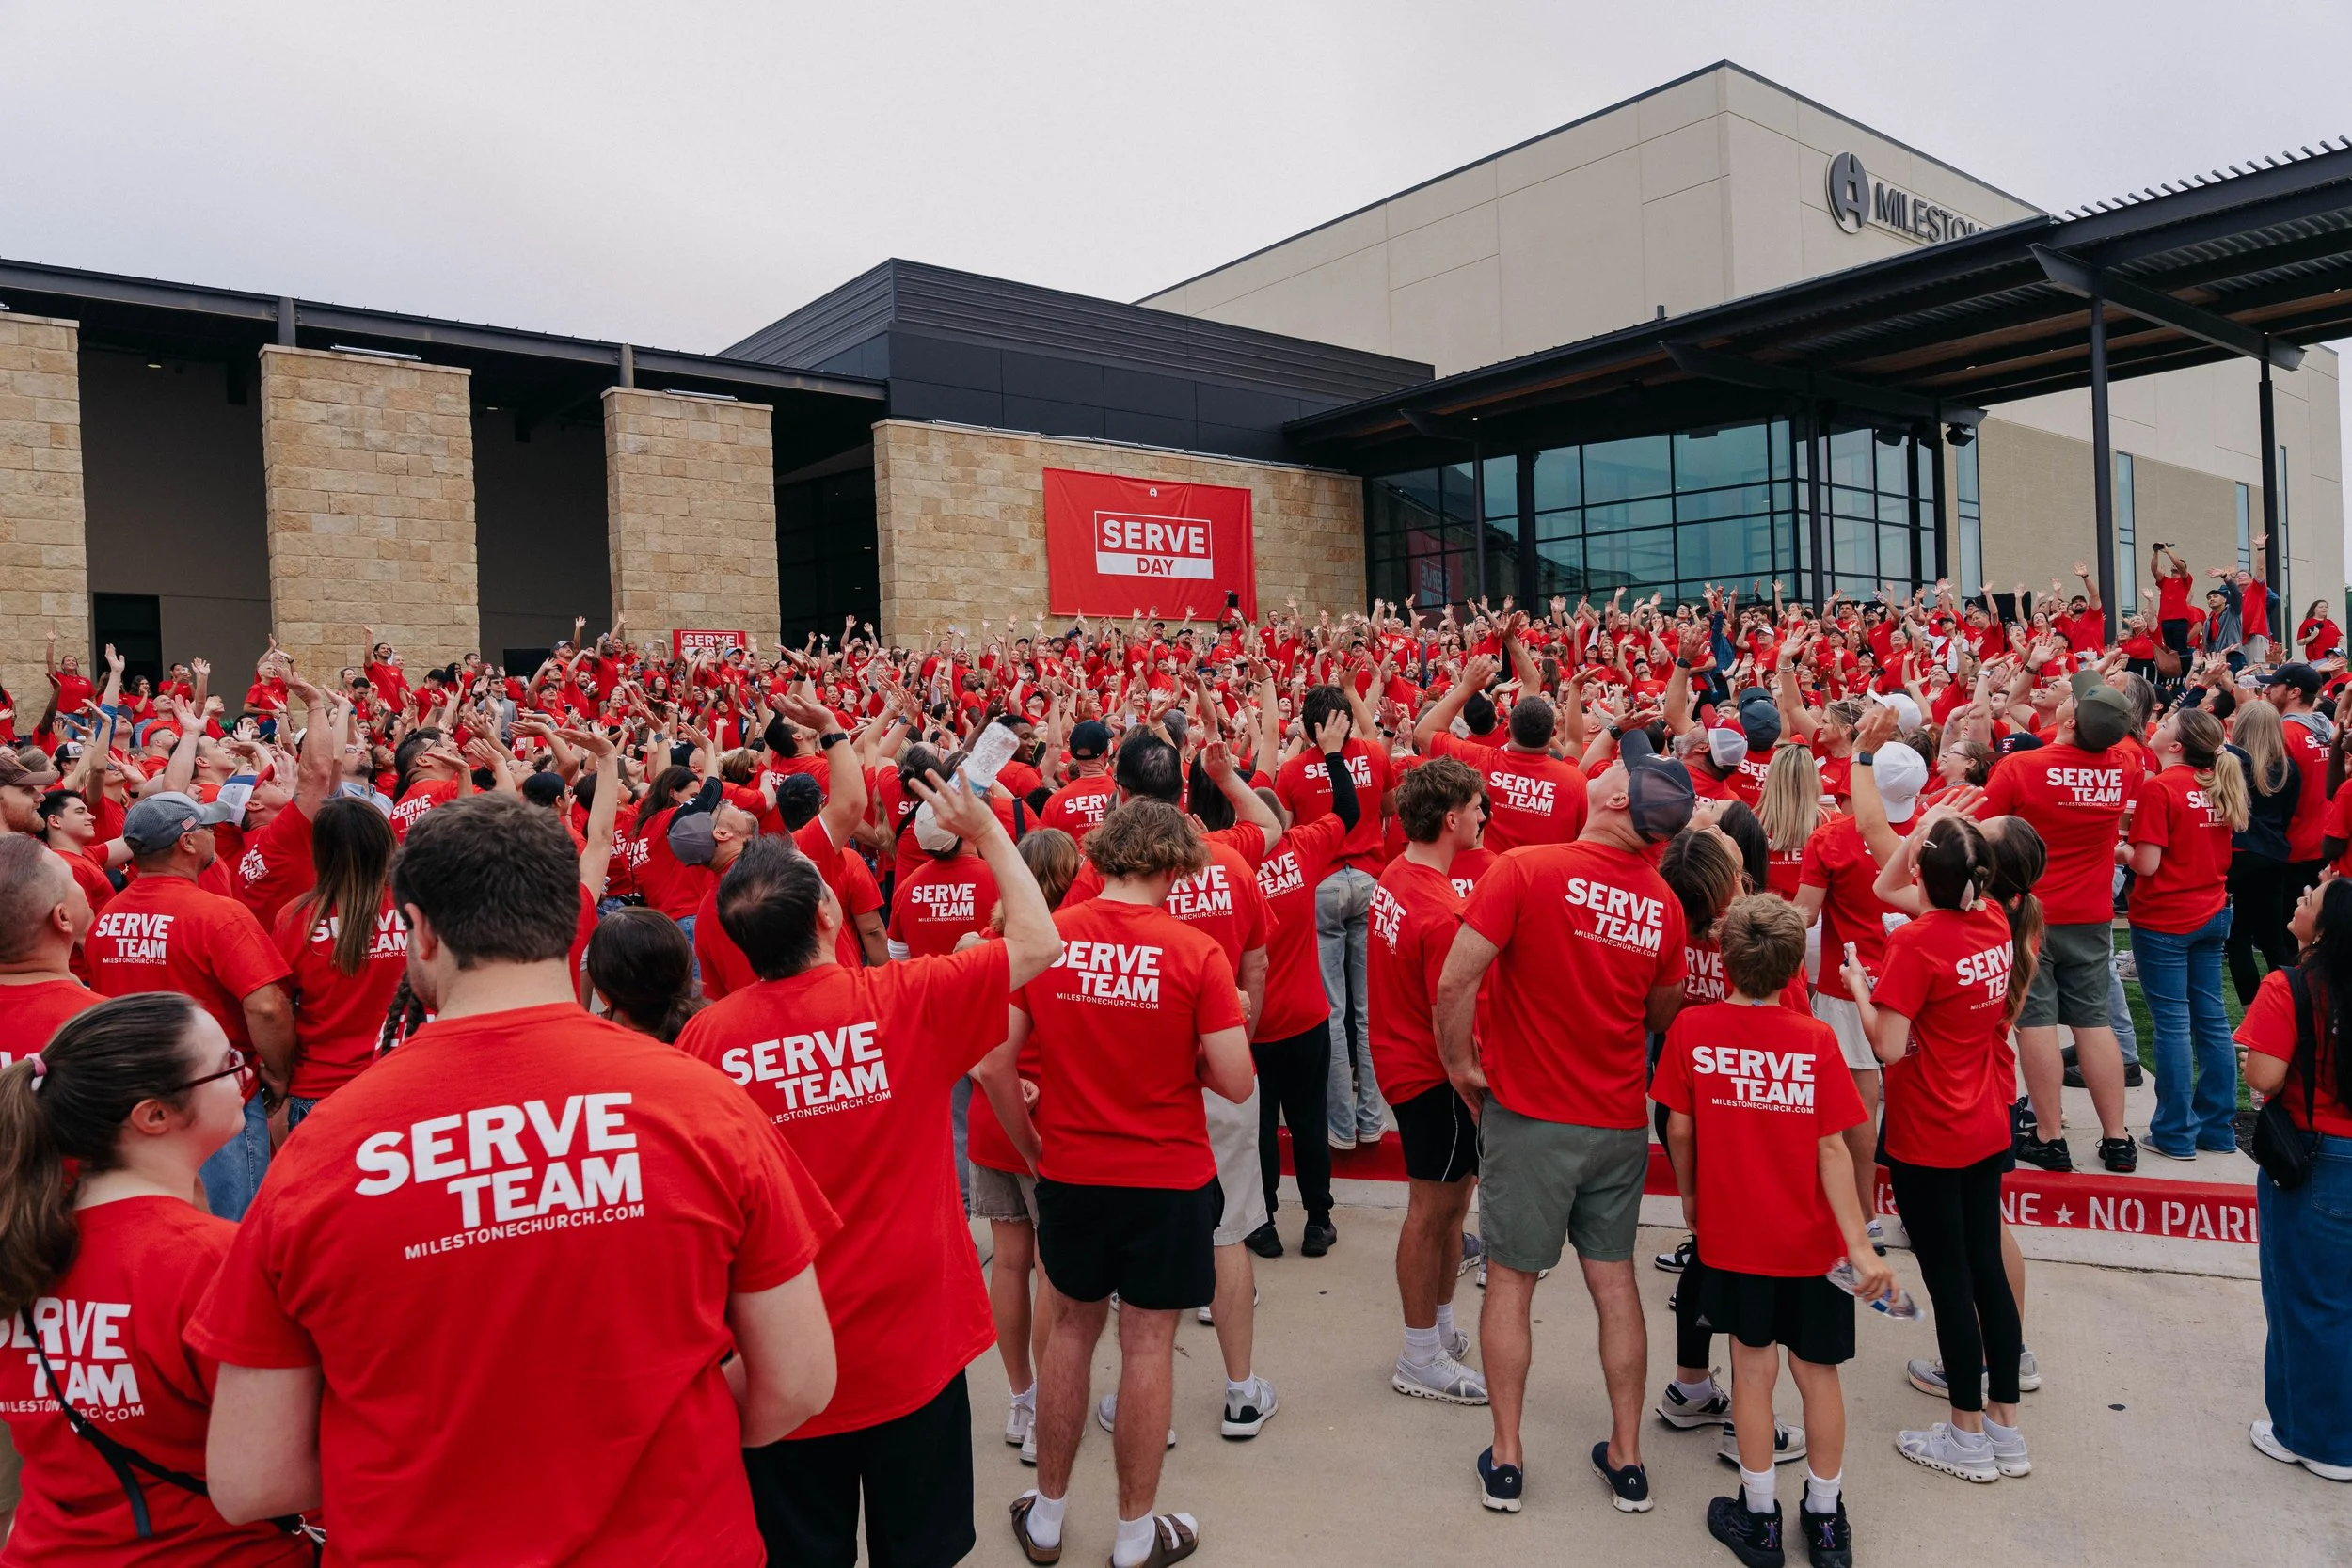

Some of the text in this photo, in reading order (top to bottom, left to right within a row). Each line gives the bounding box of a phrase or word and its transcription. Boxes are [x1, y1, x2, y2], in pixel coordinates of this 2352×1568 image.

[1875, 182, 1985, 242] MILESTO
[1103, 519, 1205, 554] SERVE
[1137, 557, 1174, 575] DAY
[1304, 755, 1370, 779] SEVE
[1739, 759, 1769, 777] SER
[2046, 768, 2122, 787] SERVE
[1489, 771, 1556, 799] SERVE
[2072, 787, 2122, 802] TEAM
[392, 794, 431, 819] SERVE
[1064, 794, 1112, 814] SERV
[1085, 810, 1104, 822] TE
[1495, 801, 1550, 816] MILESTONECHURCH.COM
[1507, 791, 1553, 813] TEAM
[1170, 865, 1229, 893] RVE
[1256, 851, 1298, 881] RVE
[911, 884, 976, 903] SERVE
[1166, 891, 1232, 914] TEAM
[1565, 878, 1663, 927] SERVE
[930, 902, 974, 917] TEAM
[95, 913, 174, 939] SERVE
[311, 910, 407, 942] SVE
[1595, 912, 1661, 951] TEAM
[116, 939, 167, 958] TEAM
[1574, 929, 1658, 958] MILESTONECHURCH.COM
[1684, 946, 1724, 978] RVE
[1056, 992, 1159, 1009] MILESTONECHURCH.COM
[1078, 971, 1159, 1002] TEAM
[1683, 974, 1725, 1001] EAM
[722, 1021, 882, 1086] SERVE
[1692, 1046, 1816, 1082] SERVE
[775, 1060, 889, 1110] TEAM
[1731, 1077, 1814, 1106] TEAM
[771, 1090, 892, 1125] LESTONECHURCH.COM
[1712, 1098, 1814, 1114] MILESTONECHURCH.COM
[354, 1092, 637, 1196] SERVE
[447, 1152, 643, 1228] TEAM
[2001, 1190, 2042, 1225] NE
[2088, 1196, 2145, 1232] NO
[405, 1203, 644, 1260] MILESTONECHURCH.COM
